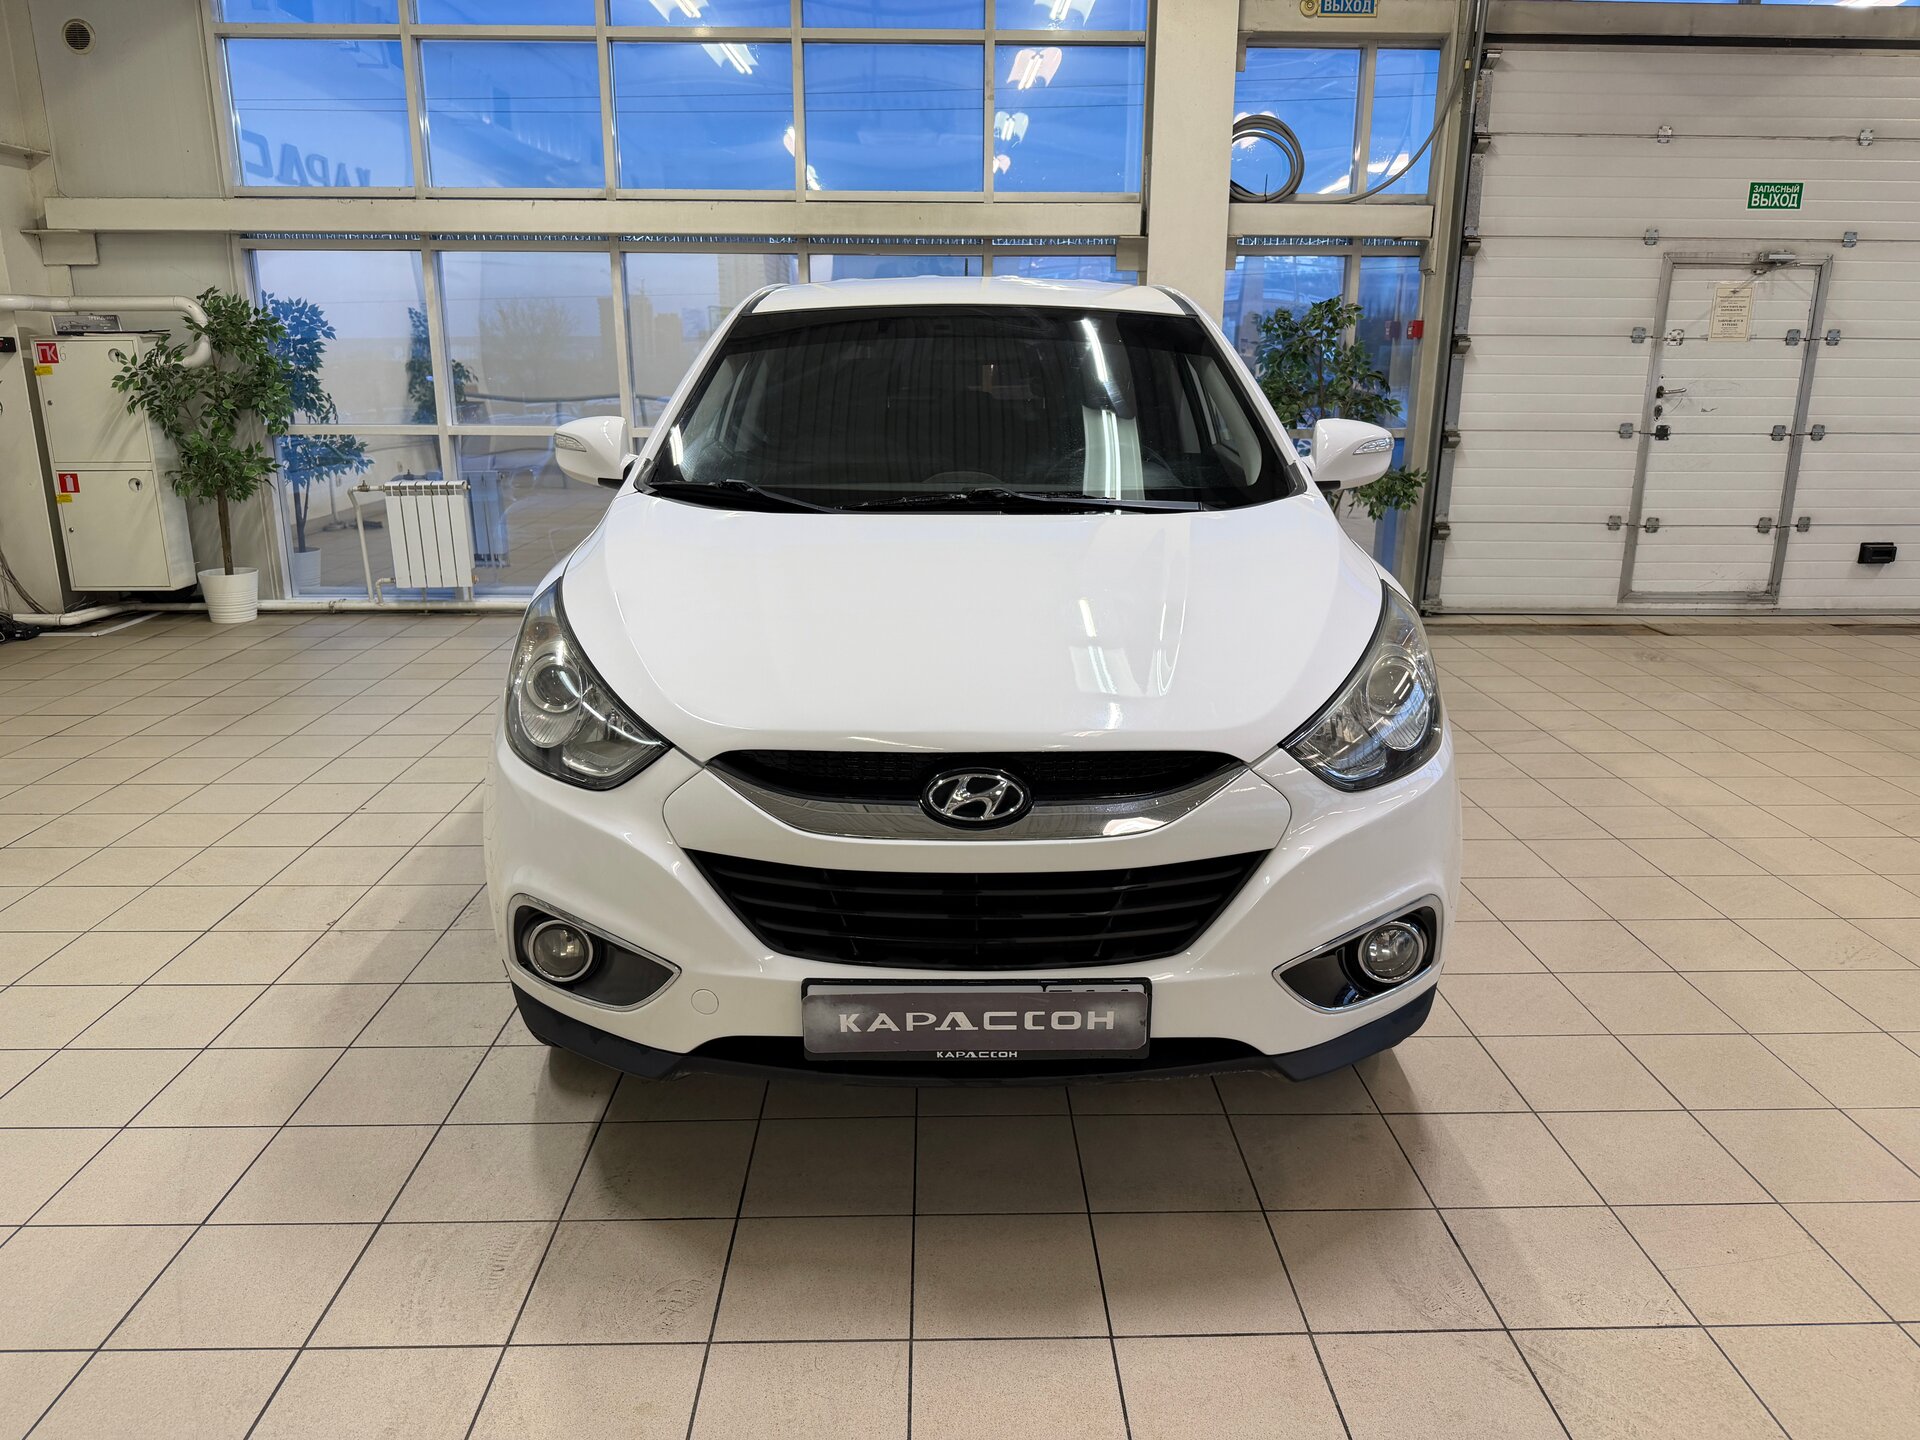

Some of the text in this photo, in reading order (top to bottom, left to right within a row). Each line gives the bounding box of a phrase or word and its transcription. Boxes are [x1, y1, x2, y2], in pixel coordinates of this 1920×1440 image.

[1323, 0, 1371, 12] ВЫХОД
[1753, 184, 1800, 193] ЗАПАСНЫЙ
[1751, 193, 1798, 208] ВЫХОД
[37, 345, 58, 361] ПК
[839, 1010, 1115, 1033] КАРАССОН
[936, 1050, 1018, 1059] КАРАССОН
